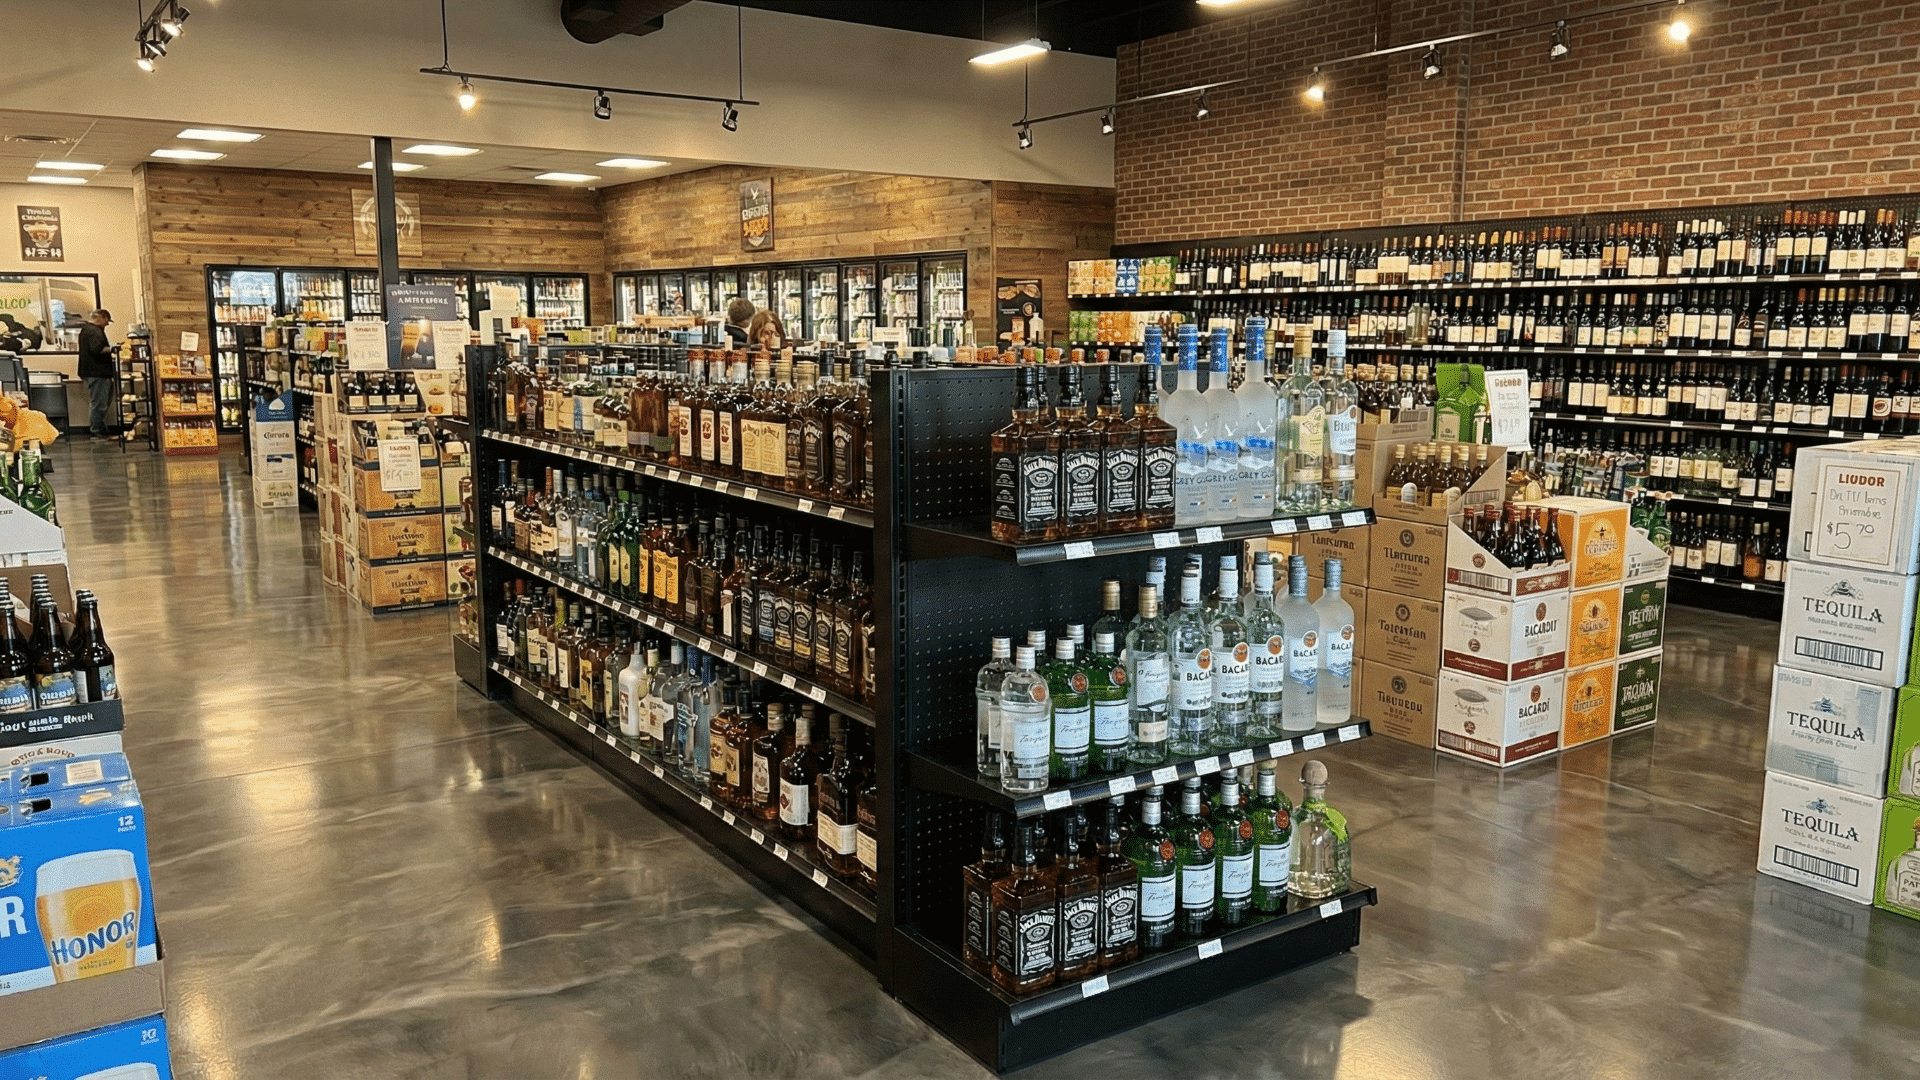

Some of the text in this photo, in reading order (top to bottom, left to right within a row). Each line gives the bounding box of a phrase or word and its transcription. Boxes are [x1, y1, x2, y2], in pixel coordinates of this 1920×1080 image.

[1802, 596, 1885, 624] TEQUILA
[1786, 710, 1865, 742] TEQUILA
[118, 815, 135, 827] 12
[1781, 808, 1860, 843] TEQUILA
[51, 911, 136, 965] HONOR
